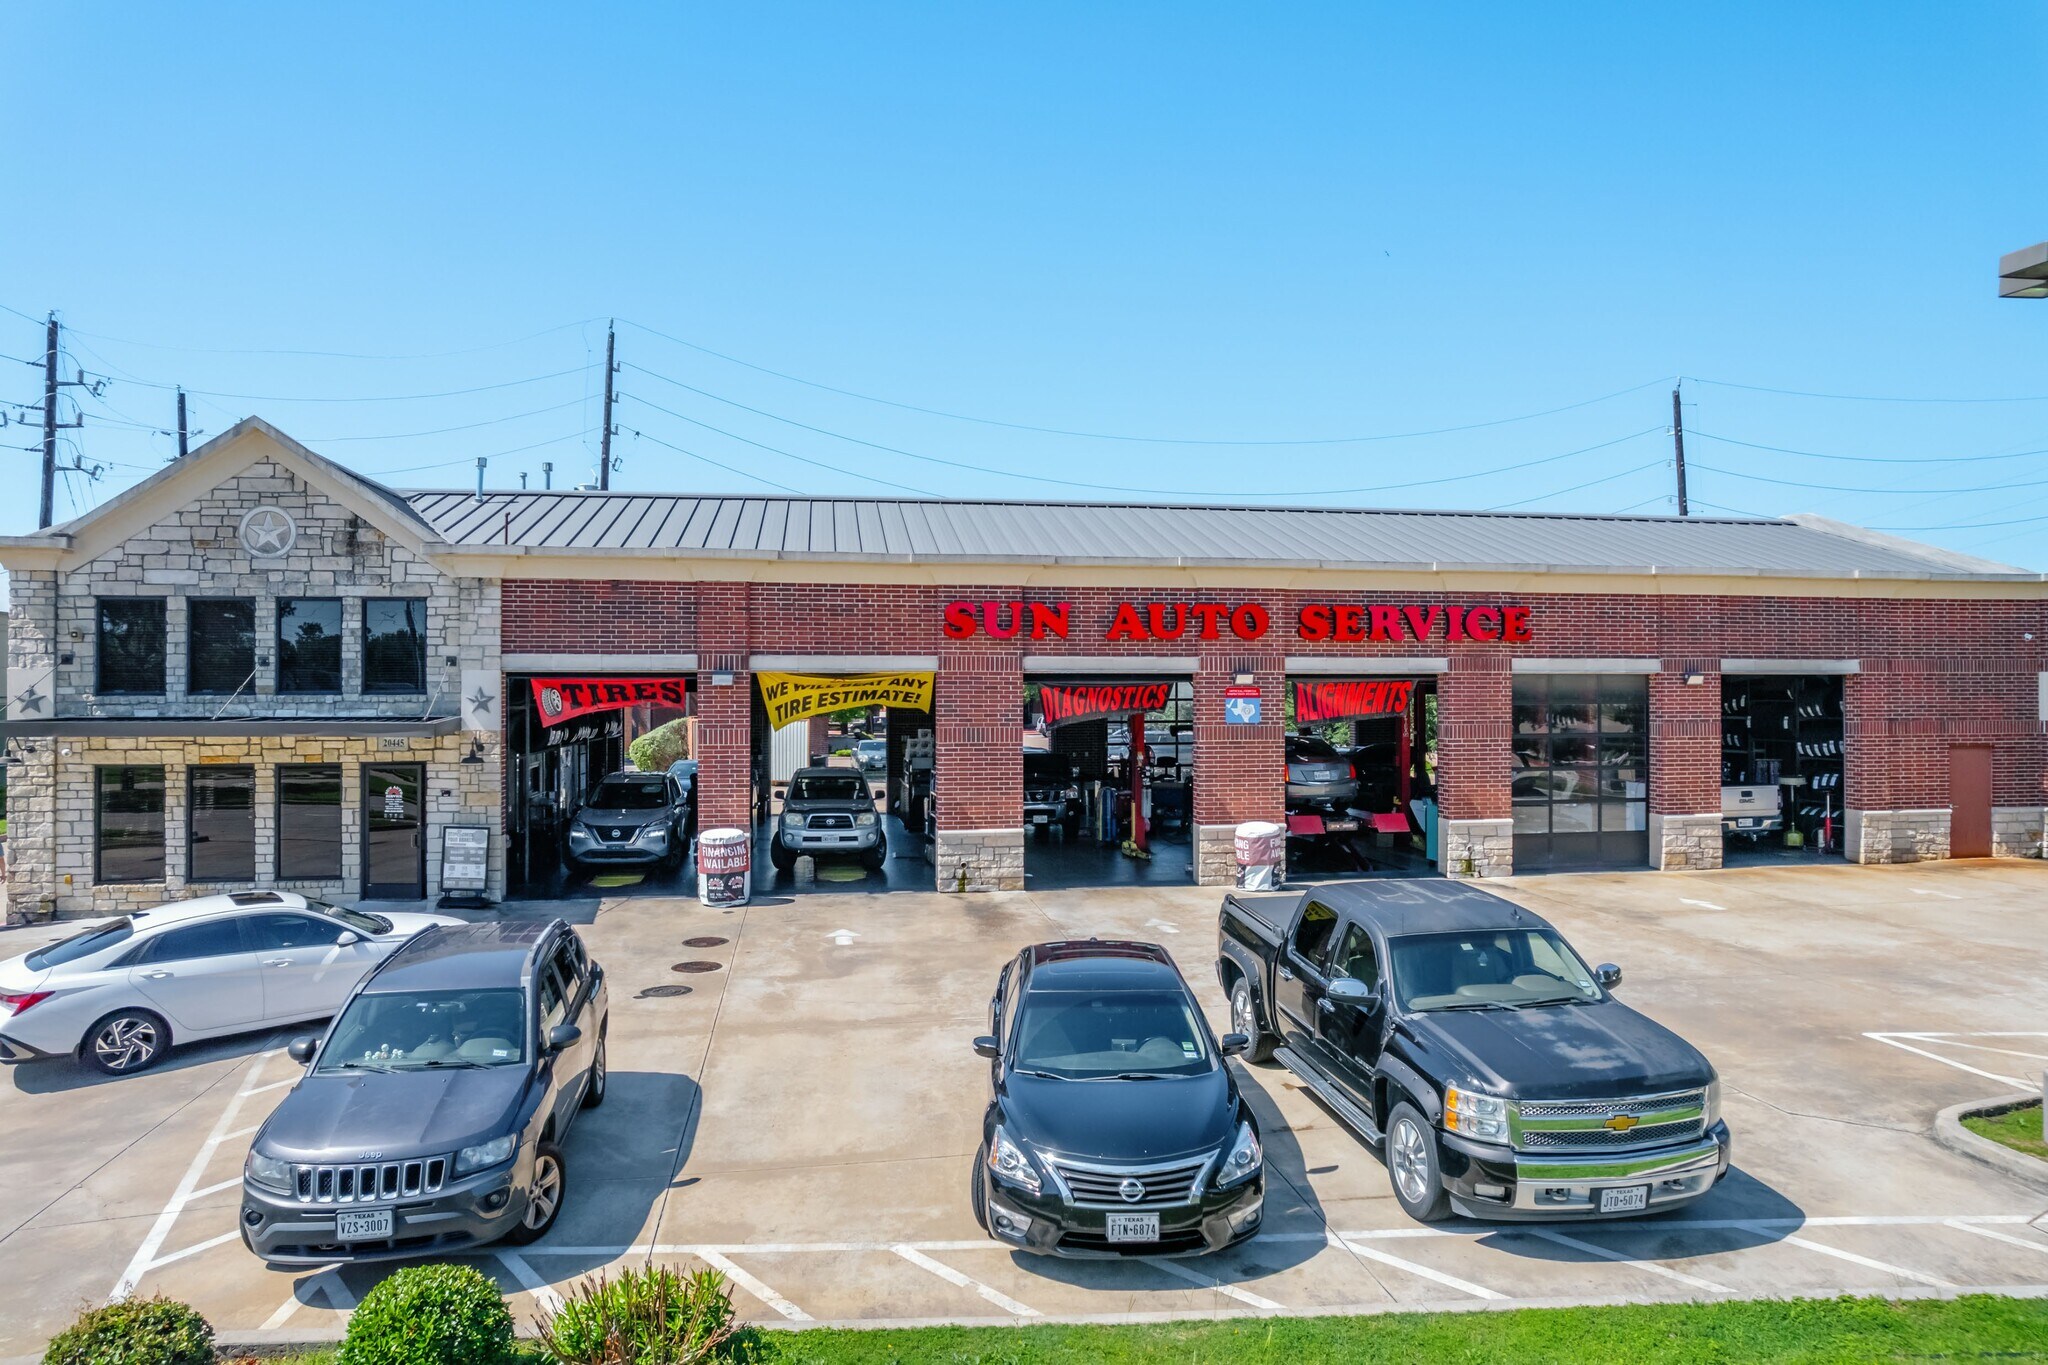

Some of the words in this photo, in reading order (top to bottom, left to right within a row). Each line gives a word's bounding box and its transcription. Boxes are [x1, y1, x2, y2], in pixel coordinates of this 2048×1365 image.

[943, 601, 1072, 640] SUN
[1104, 602, 1270, 640] AUTO
[1298, 604, 1533, 642] SERVICE
[561, 681, 682, 710] TIRES
[765, 681, 789, 701] WE
[888, 677, 928, 689] ANY
[1297, 681, 1412, 722] ALIGNMENTS
[775, 695, 812, 723] TIRE
[817, 689, 922, 708] ESTIMATE!
[1041, 684, 1168, 724] DIAGNOSTICS
[383, 738, 405, 747] 20445
[702, 844, 746, 857] FINANCING
[359, 1151, 383, 1159] Jeep
